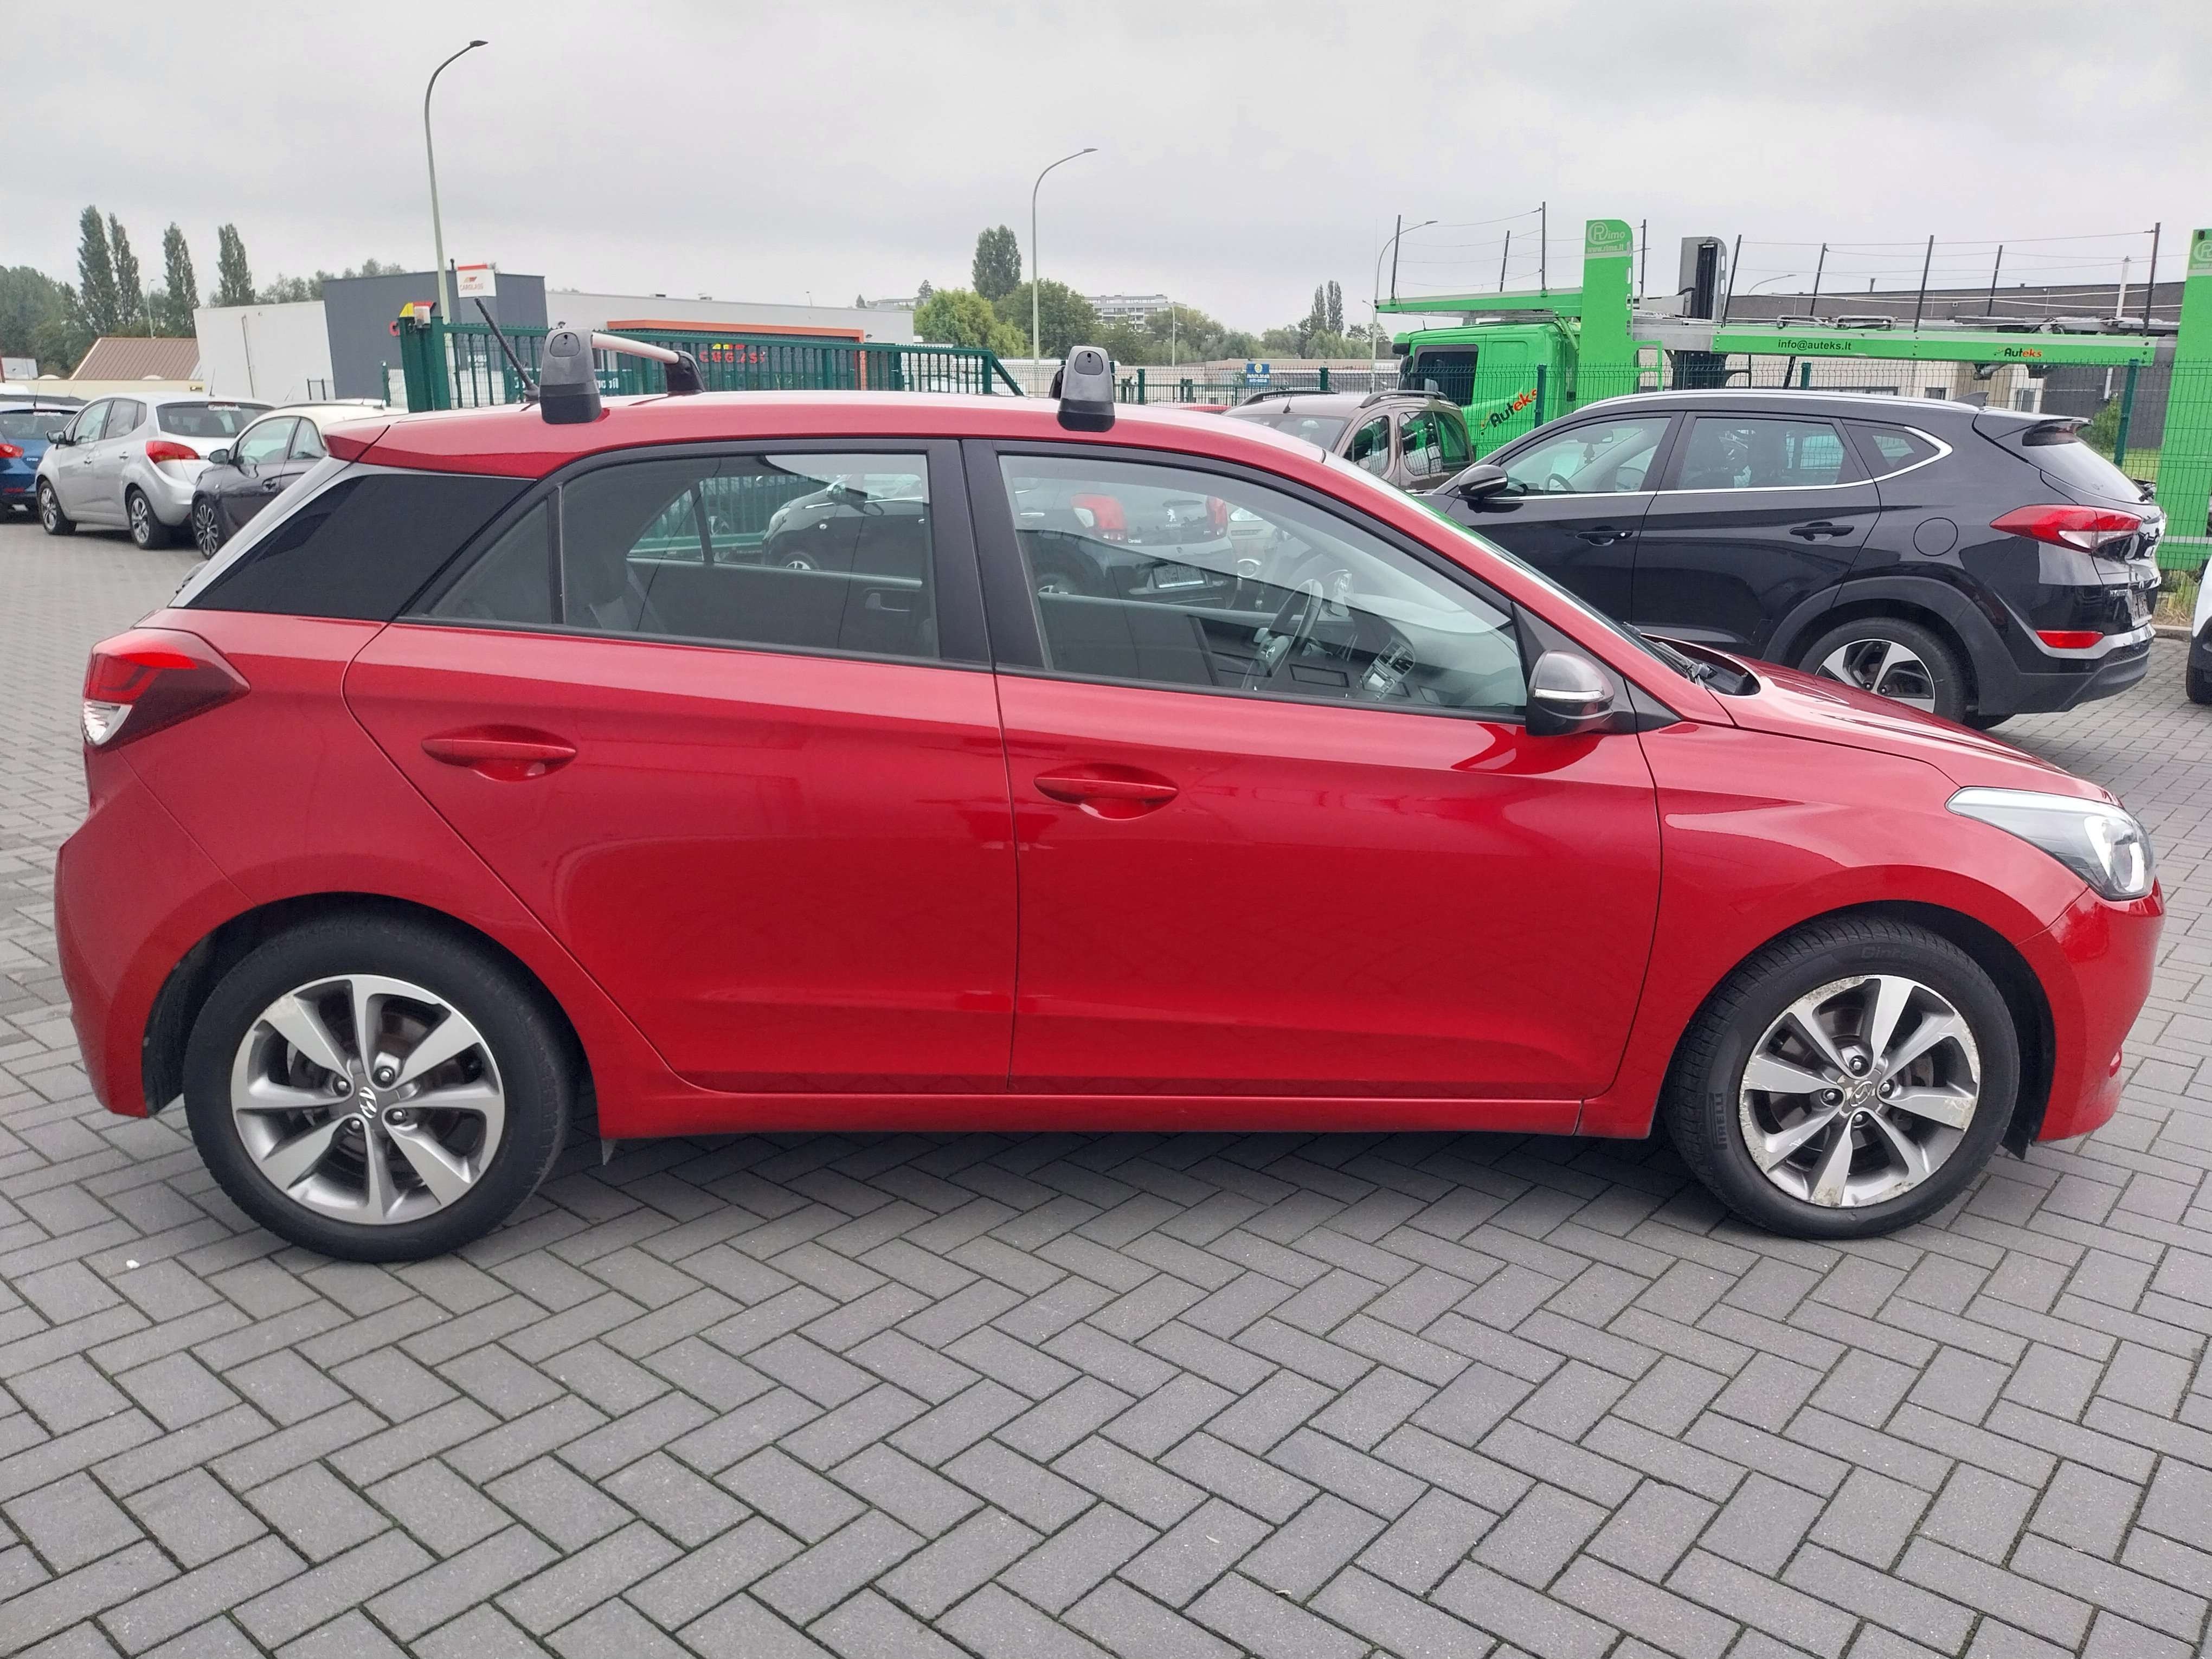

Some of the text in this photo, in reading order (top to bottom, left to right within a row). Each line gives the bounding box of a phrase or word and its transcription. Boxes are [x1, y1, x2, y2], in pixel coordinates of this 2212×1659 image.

[1778, 339, 1852, 351] info@auteks.lt
[2004, 348, 2042, 358] Auteks
[1709, 1092, 1727, 1149] PIRELLI
